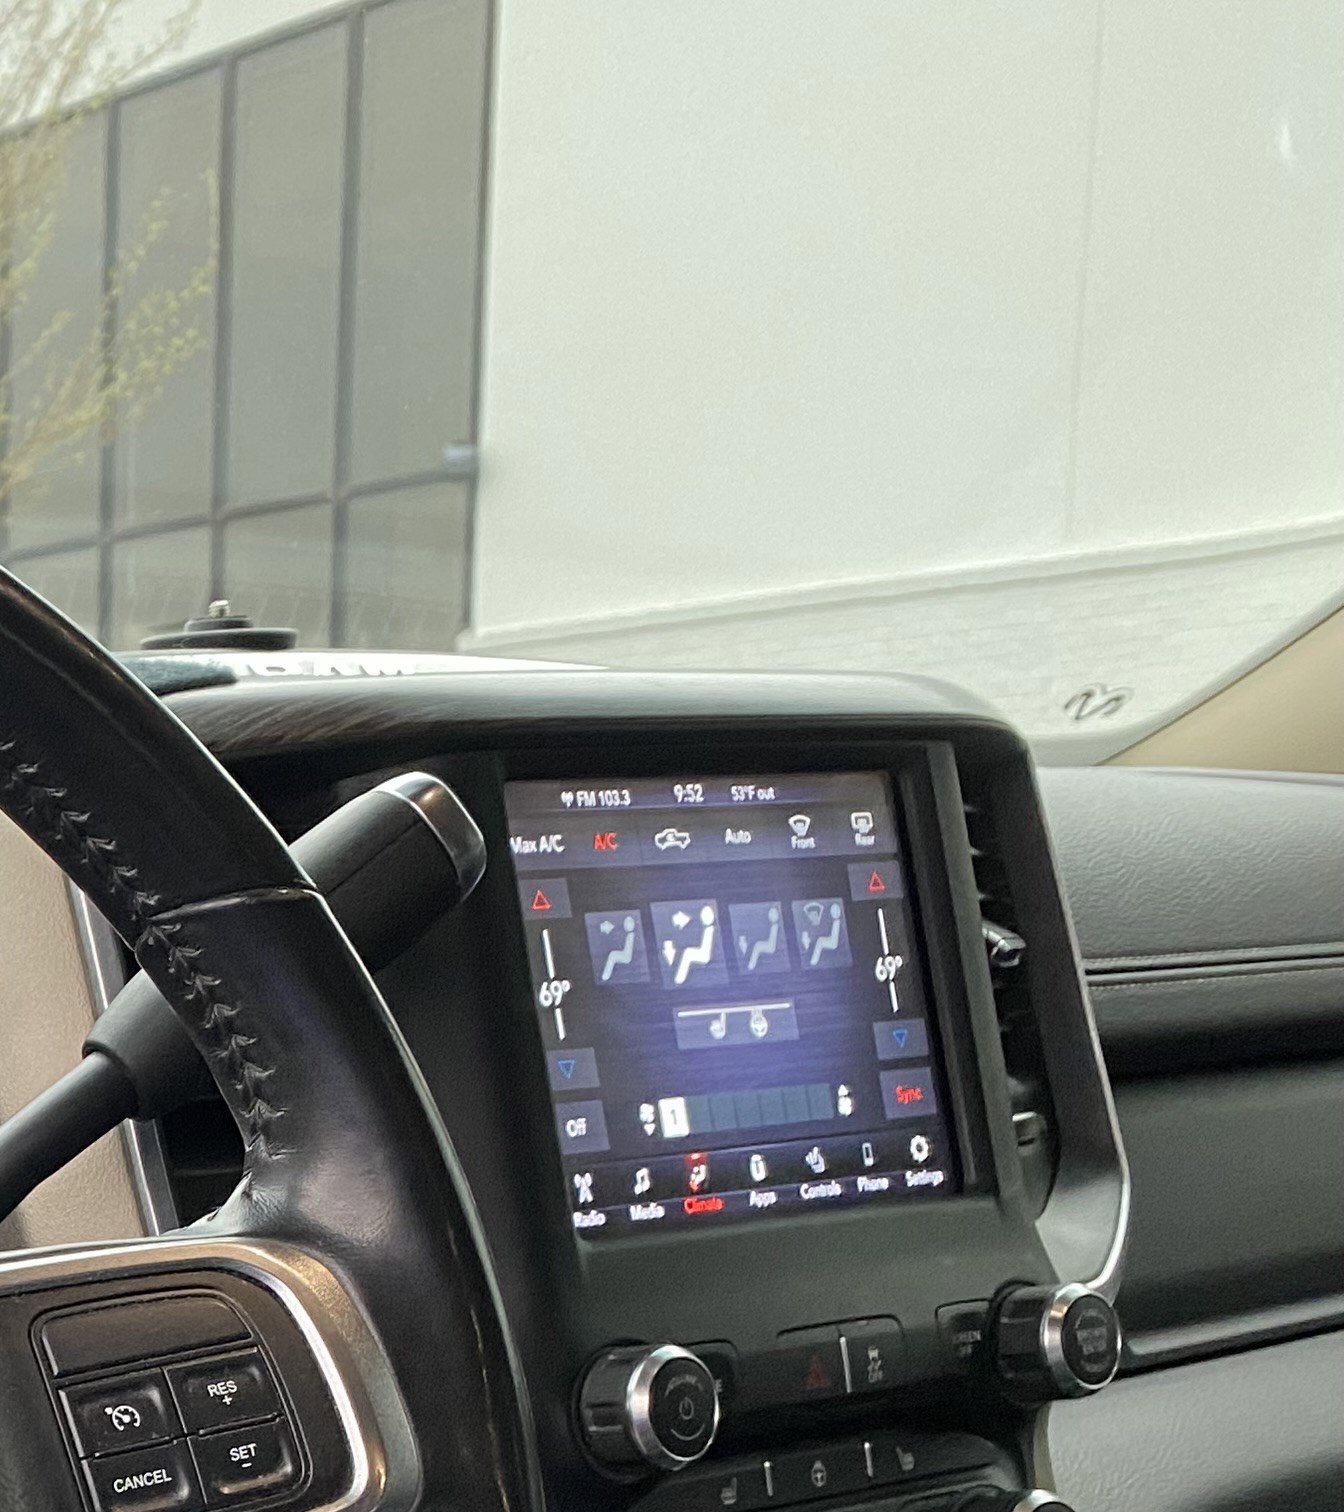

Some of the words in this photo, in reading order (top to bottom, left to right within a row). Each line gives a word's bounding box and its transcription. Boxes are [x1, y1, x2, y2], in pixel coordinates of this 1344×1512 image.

[576, 791, 596, 807] FM
[598, 789, 631, 807] 103.3
[673, 783, 705, 803] 9:52
[757, 786, 776, 801] out
[539, 834, 566, 853] A/C
[592, 832, 618, 850] A/C
[725, 828, 752, 845] Auto
[895, 1085, 923, 1104] Sync
[565, 1117, 587, 1137] Off
[799, 1179, 842, 1200] Controls
[857, 1175, 889, 1192] Phone
[683, 1196, 725, 1215] Climate
[749, 1190, 778, 1208] Apps
[629, 1202, 666, 1221] Media
[206, 1379, 238, 1398] RES
[229, 1442, 257, 1462] SET
[113, 1468, 173, 1494] CANCEL
